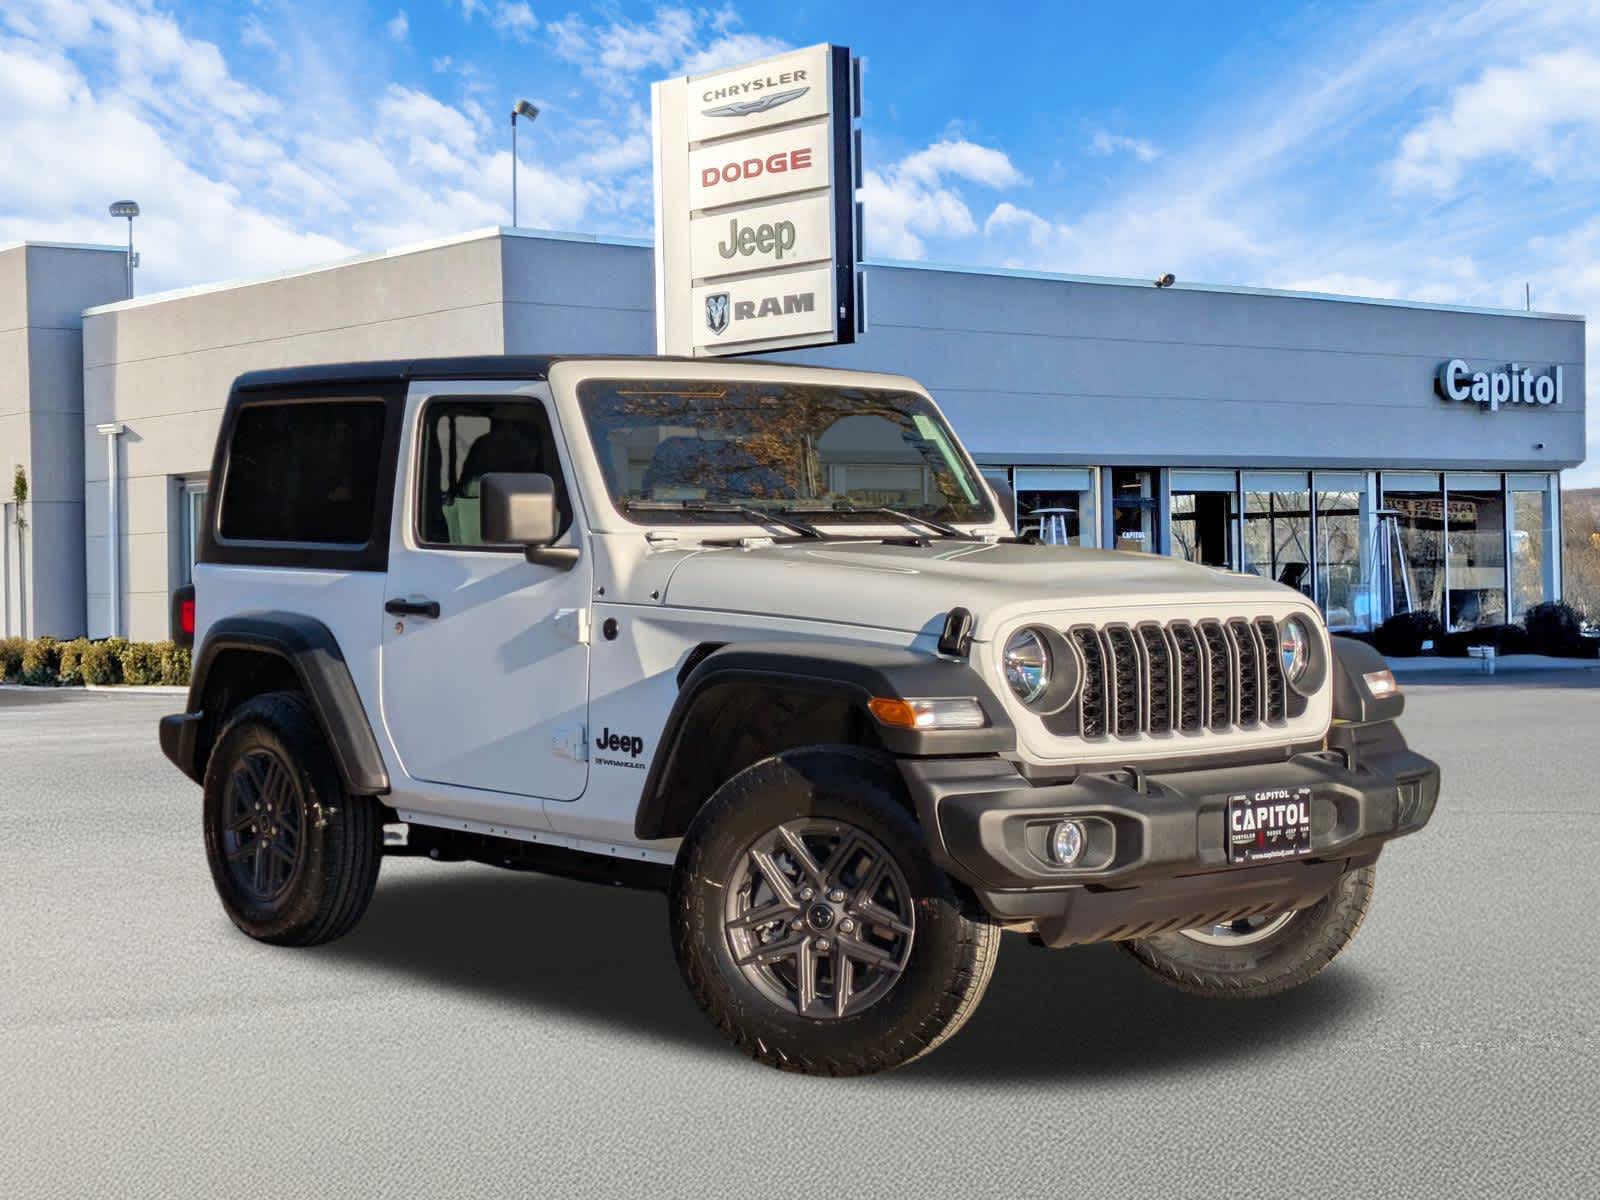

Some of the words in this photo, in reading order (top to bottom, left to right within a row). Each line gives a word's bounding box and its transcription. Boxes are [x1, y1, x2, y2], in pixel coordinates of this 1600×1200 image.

[702, 70, 808, 102] CHRYSLER
[702, 147, 812, 187] DODGE
[718, 218, 795, 259] Jeep
[735, 292, 815, 320] RAM
[1446, 359, 1563, 411] Capitol
[596, 727, 643, 758] Jeep
[604, 759, 646, 769] WRANGLER
[1255, 790, 1290, 801] CAPITOL
[1232, 803, 1309, 831] CAPITOL
